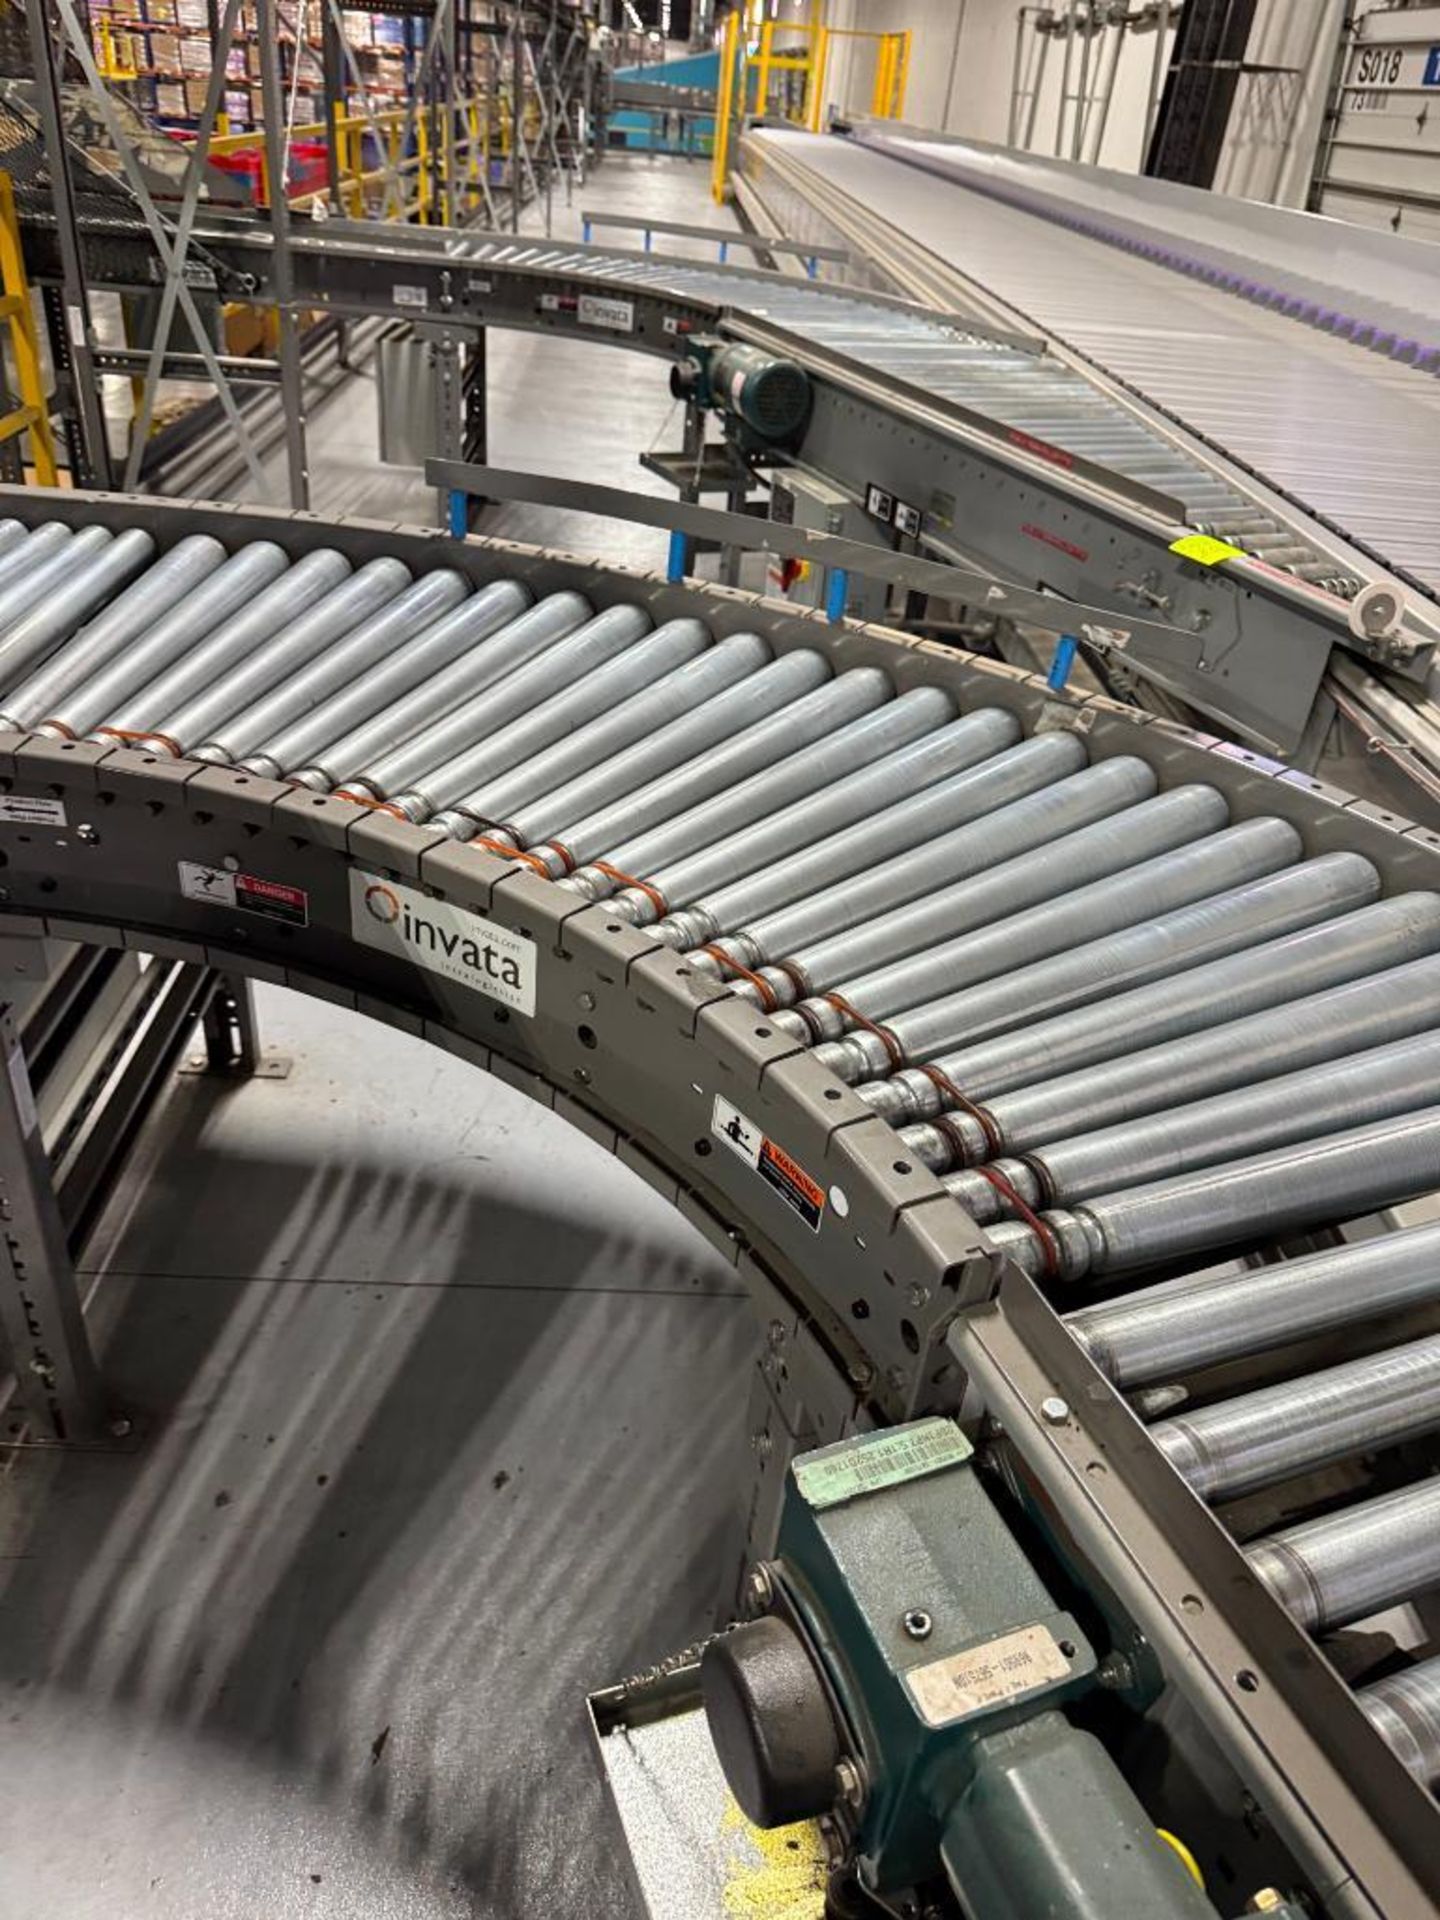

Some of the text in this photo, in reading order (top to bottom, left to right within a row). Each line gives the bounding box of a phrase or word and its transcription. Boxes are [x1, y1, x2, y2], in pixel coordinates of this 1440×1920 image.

[1358, 49, 1403, 83] S018
[253, 882, 296, 901] DANGER
[403, 904, 522, 990] invata
[773, 1151, 820, 1203] WARNING
